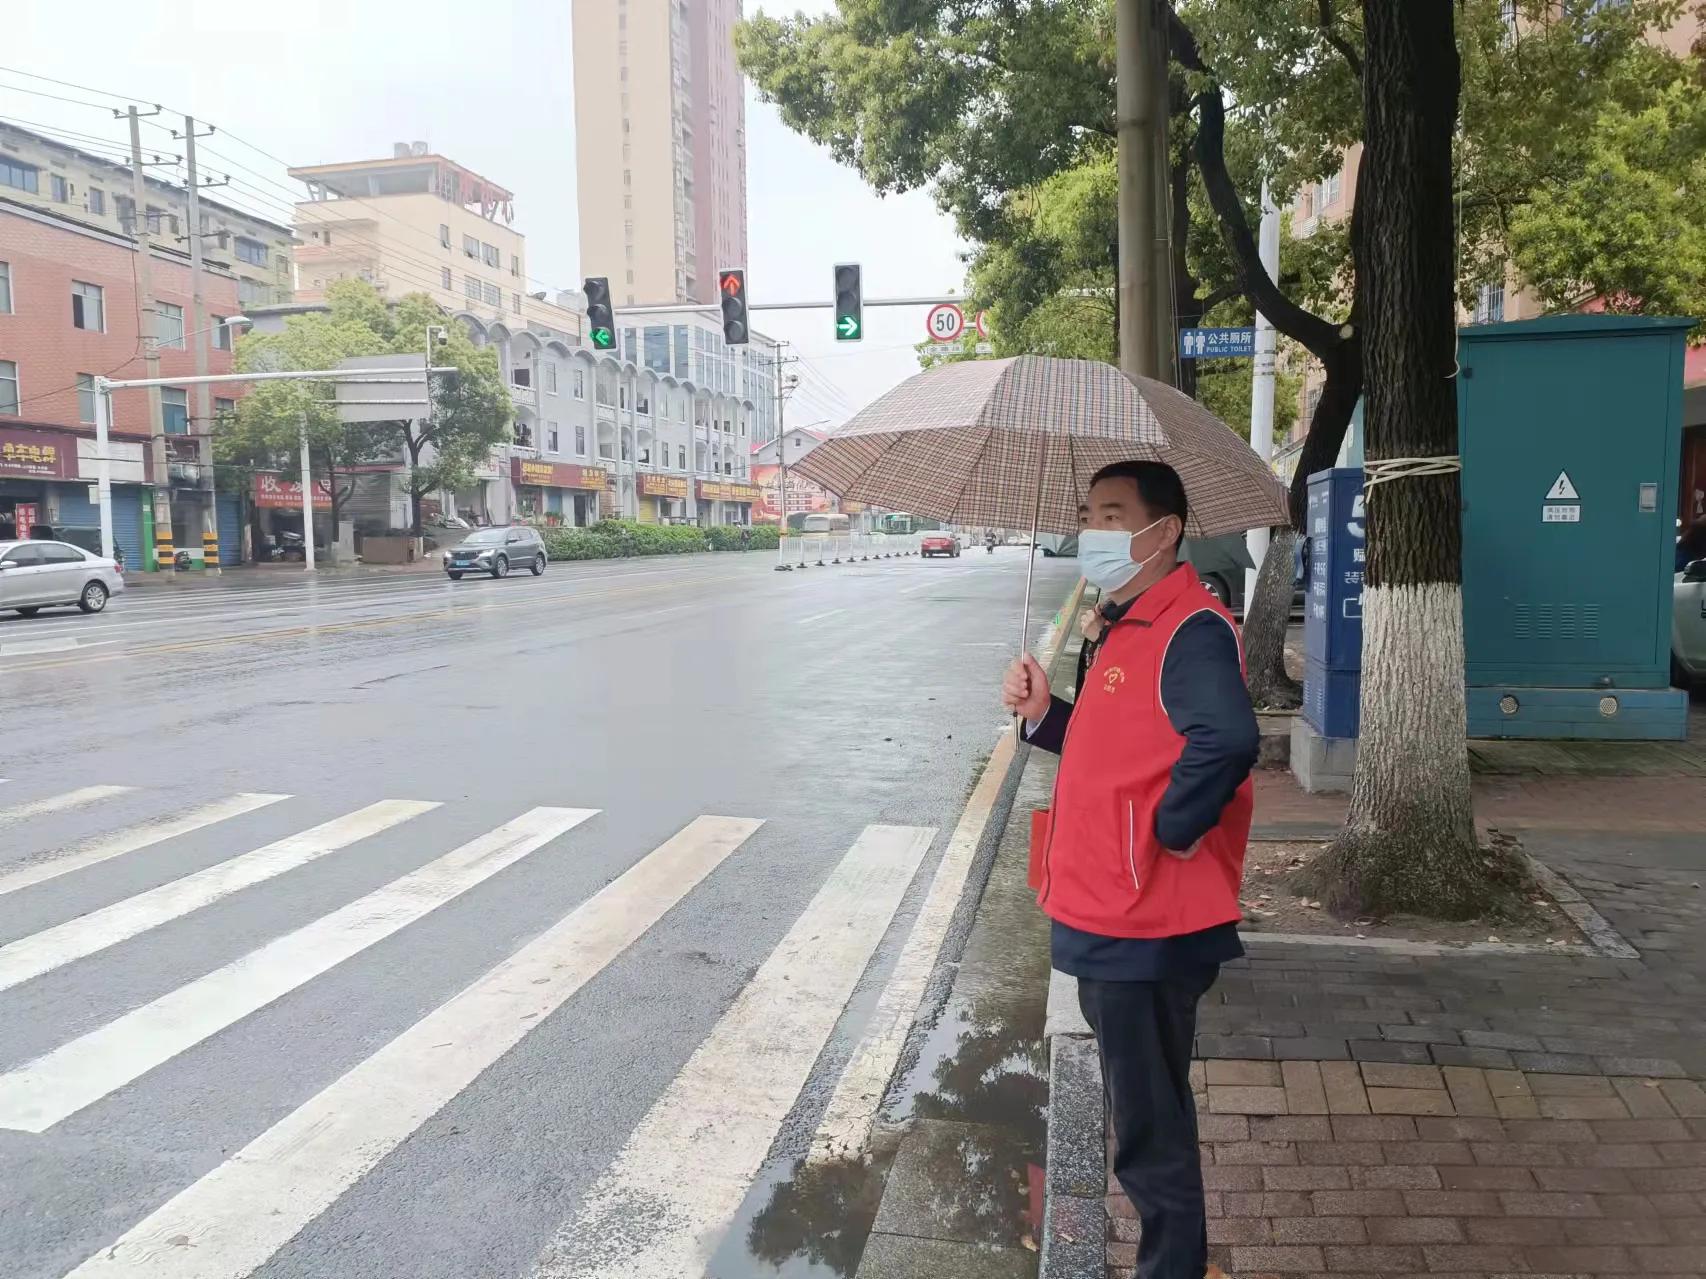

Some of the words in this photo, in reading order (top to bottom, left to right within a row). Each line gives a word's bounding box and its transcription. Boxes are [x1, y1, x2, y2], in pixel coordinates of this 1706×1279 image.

[936, 313, 955, 331] 50
[1208, 331, 1252, 345] 公共厕所
